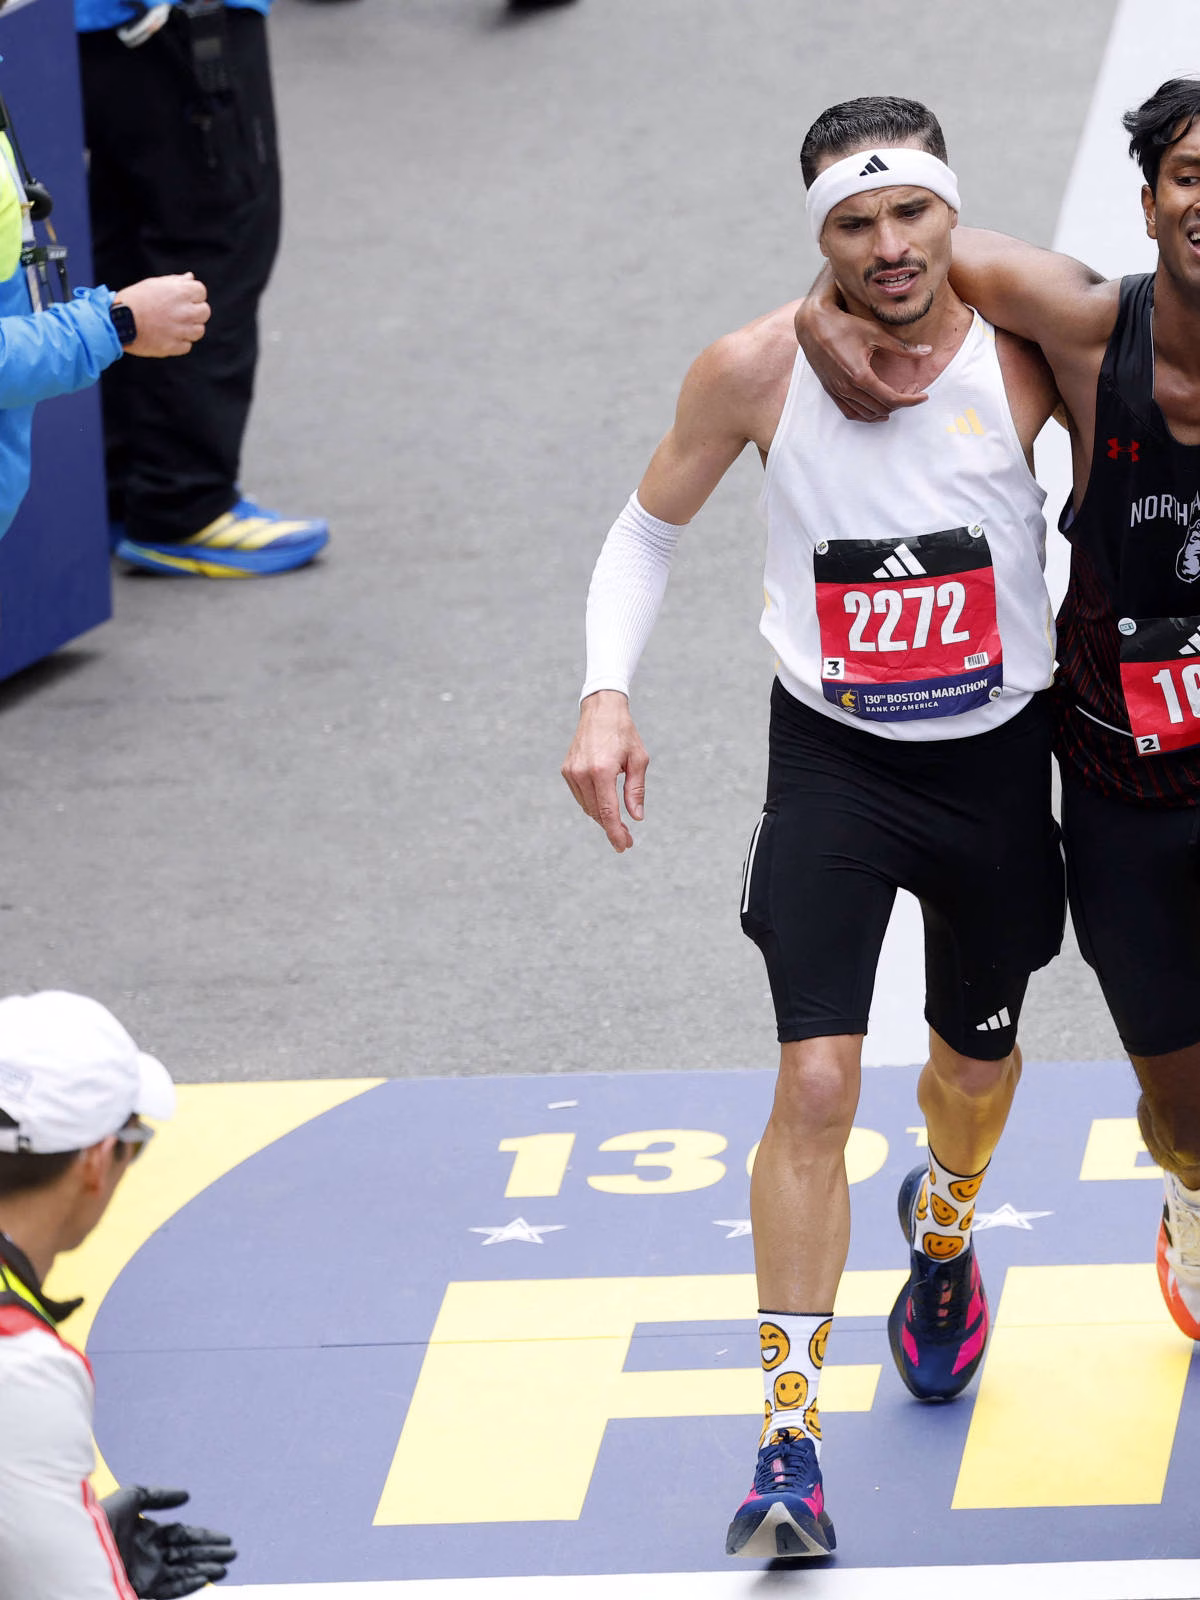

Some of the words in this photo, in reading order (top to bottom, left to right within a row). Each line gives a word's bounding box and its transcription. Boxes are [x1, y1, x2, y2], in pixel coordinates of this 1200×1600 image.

[843, 582, 970, 652] 2272
[826, 661, 840, 676] 3
[887, 691, 929, 703] BOSTON
[931, 679, 988, 699] MARATHON
[902, 701, 939, 711] AMERICA
[1141, 739, 1156, 752] 2
